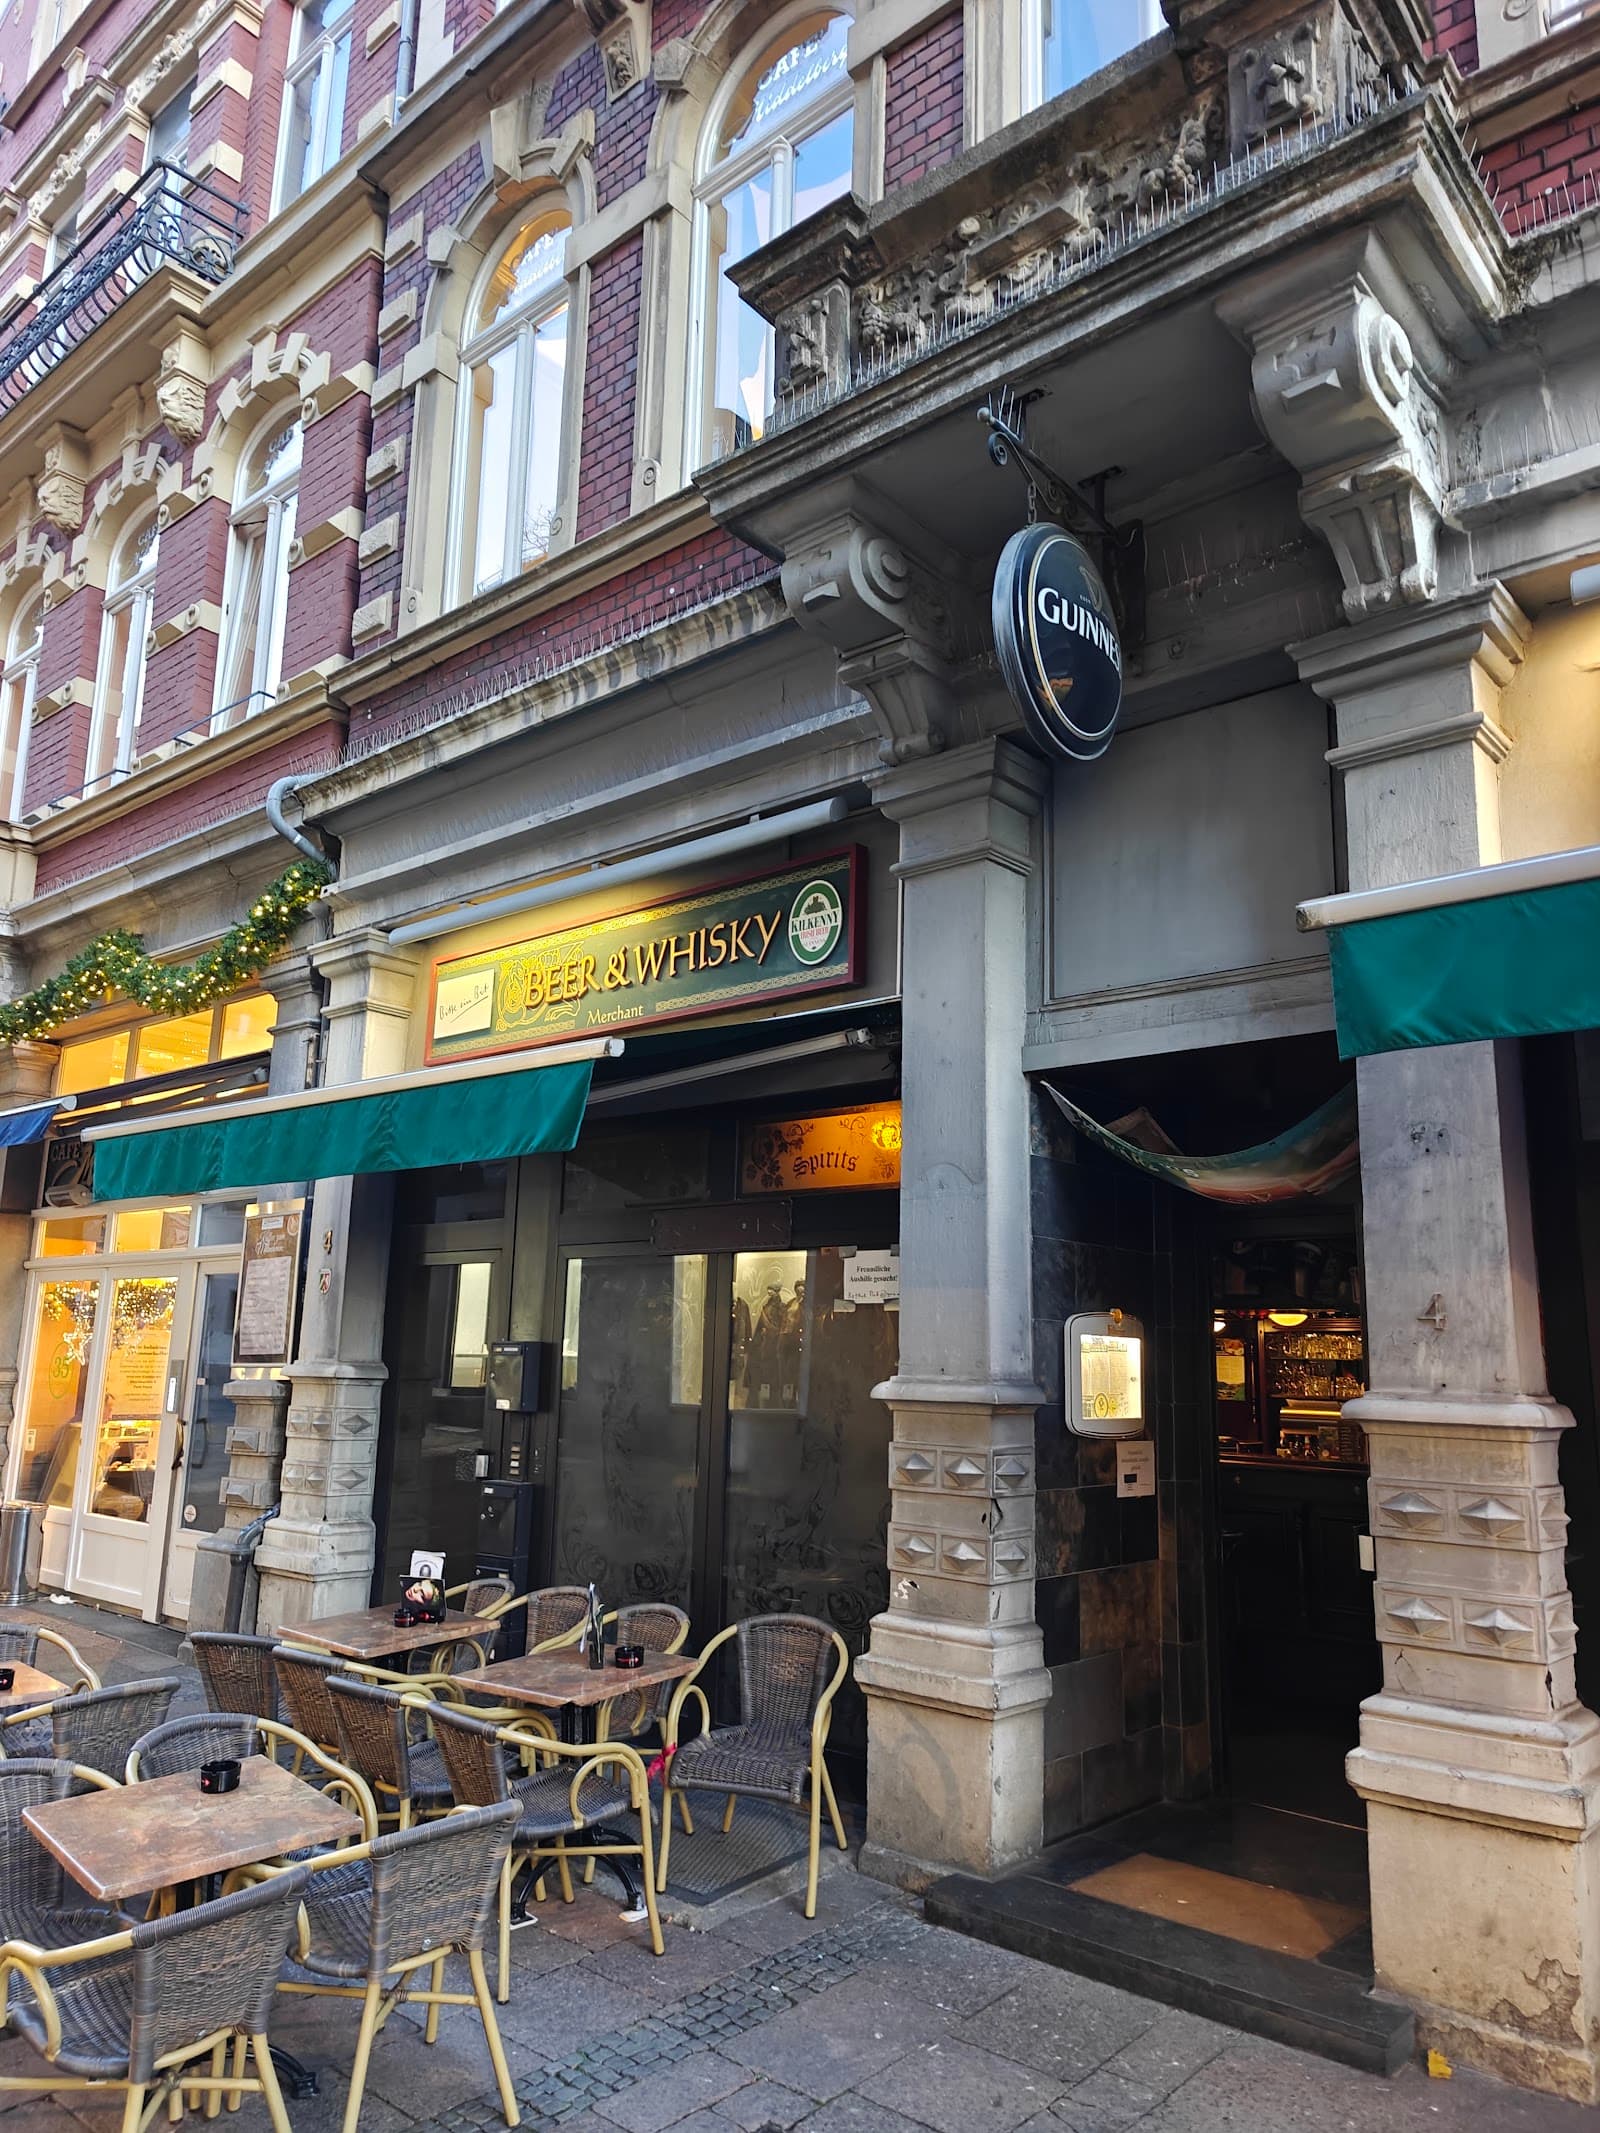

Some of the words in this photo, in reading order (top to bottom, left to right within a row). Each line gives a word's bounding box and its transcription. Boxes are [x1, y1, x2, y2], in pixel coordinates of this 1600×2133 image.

[792, 911, 840, 934] KILKENNY
[525, 954, 601, 1007] BEER
[604, 944, 632, 990] &
[633, 910, 781, 985] WHISKY
[587, 1004, 644, 1028] Merchant
[793, 1147, 860, 1178] Spirits
[322, 1229, 334, 1255] 4
[1416, 1292, 1448, 1332] 4
[52, 1355, 70, 1378] 35
